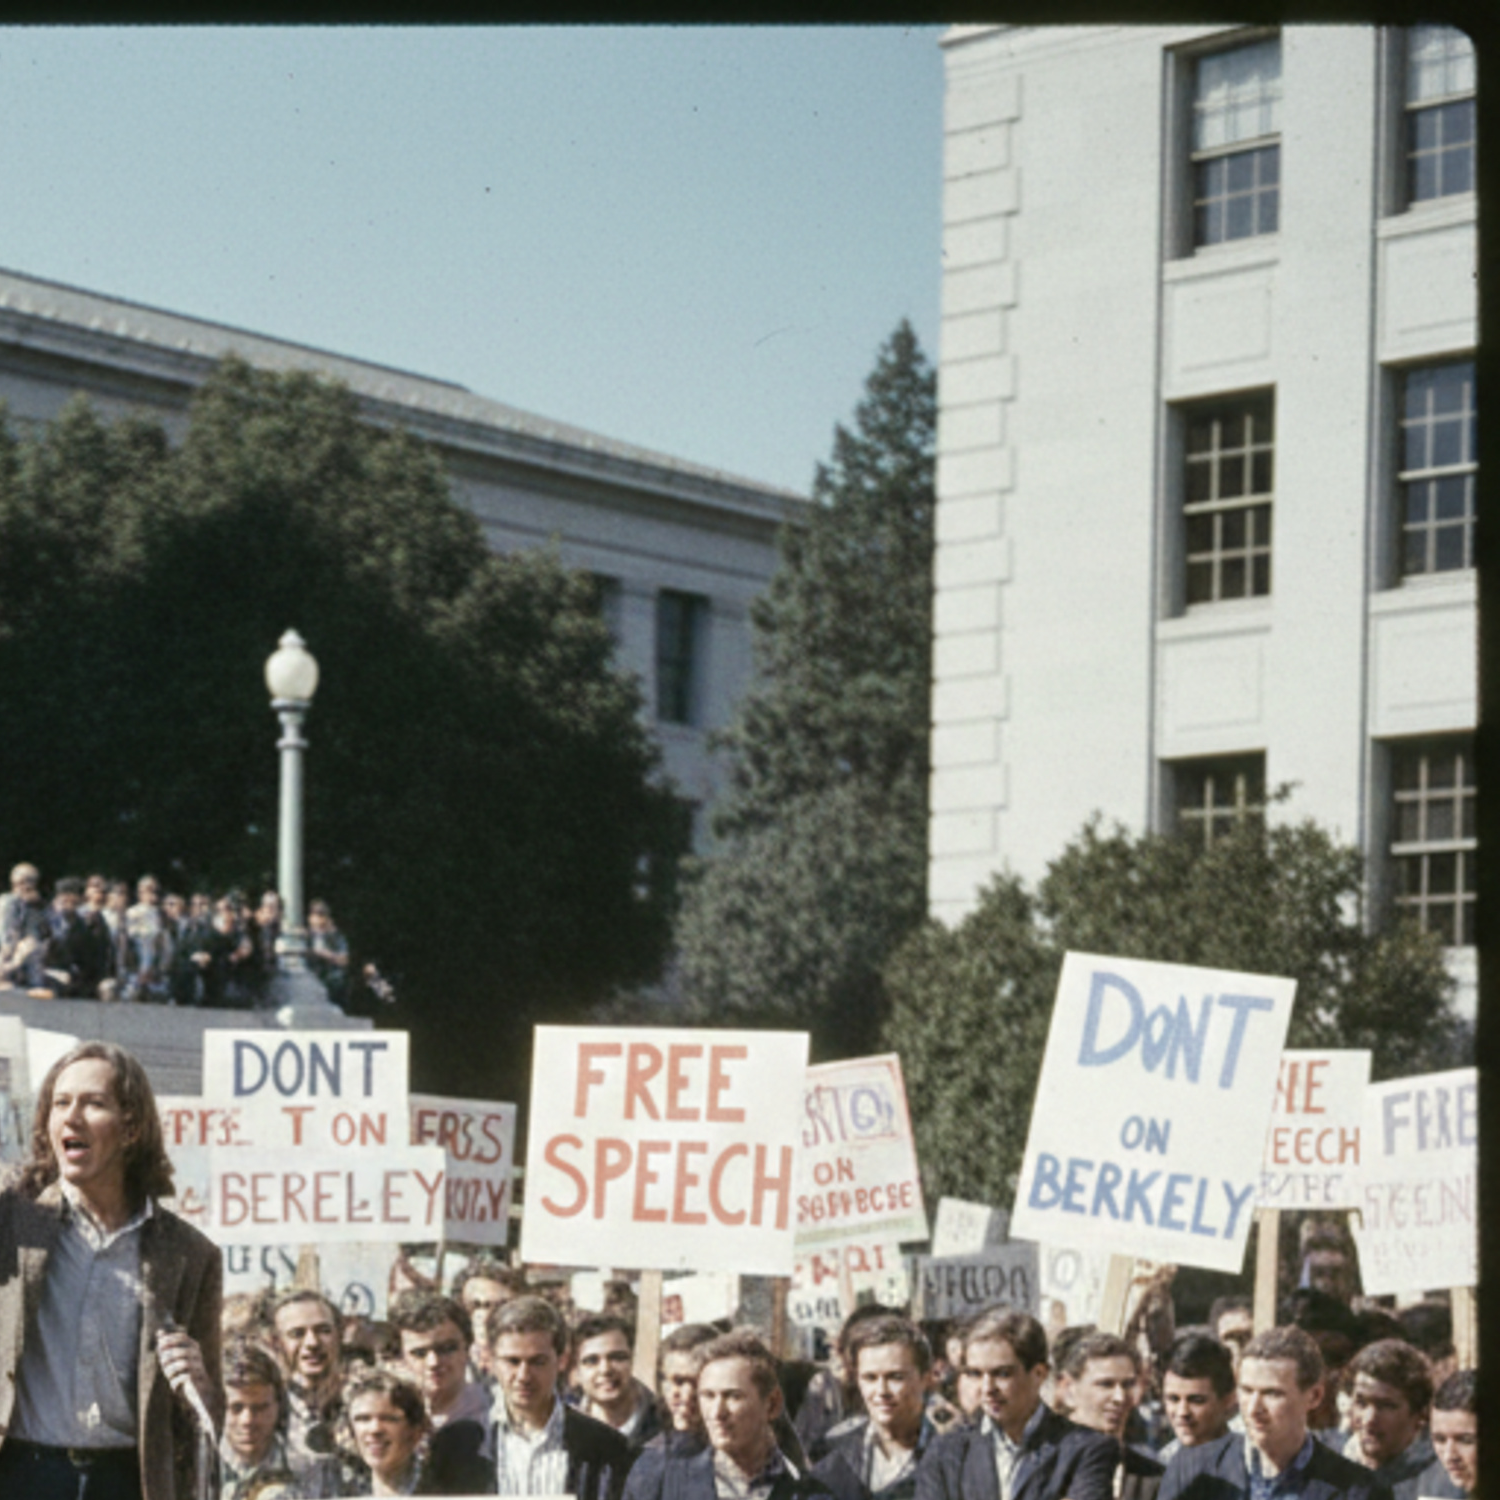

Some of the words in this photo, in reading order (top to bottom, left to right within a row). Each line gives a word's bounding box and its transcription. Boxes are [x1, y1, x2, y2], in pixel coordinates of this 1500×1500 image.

[233, 1040, 388, 1097] DONT
[1077, 971, 1275, 1089] DONT
[574, 1042, 748, 1123] FREE
[331, 1112, 387, 1146] ON
[1120, 1115, 1171, 1154] ON
[541, 1133, 794, 1231] SPEECH
[1027, 1152, 1255, 1240] BERKELY
